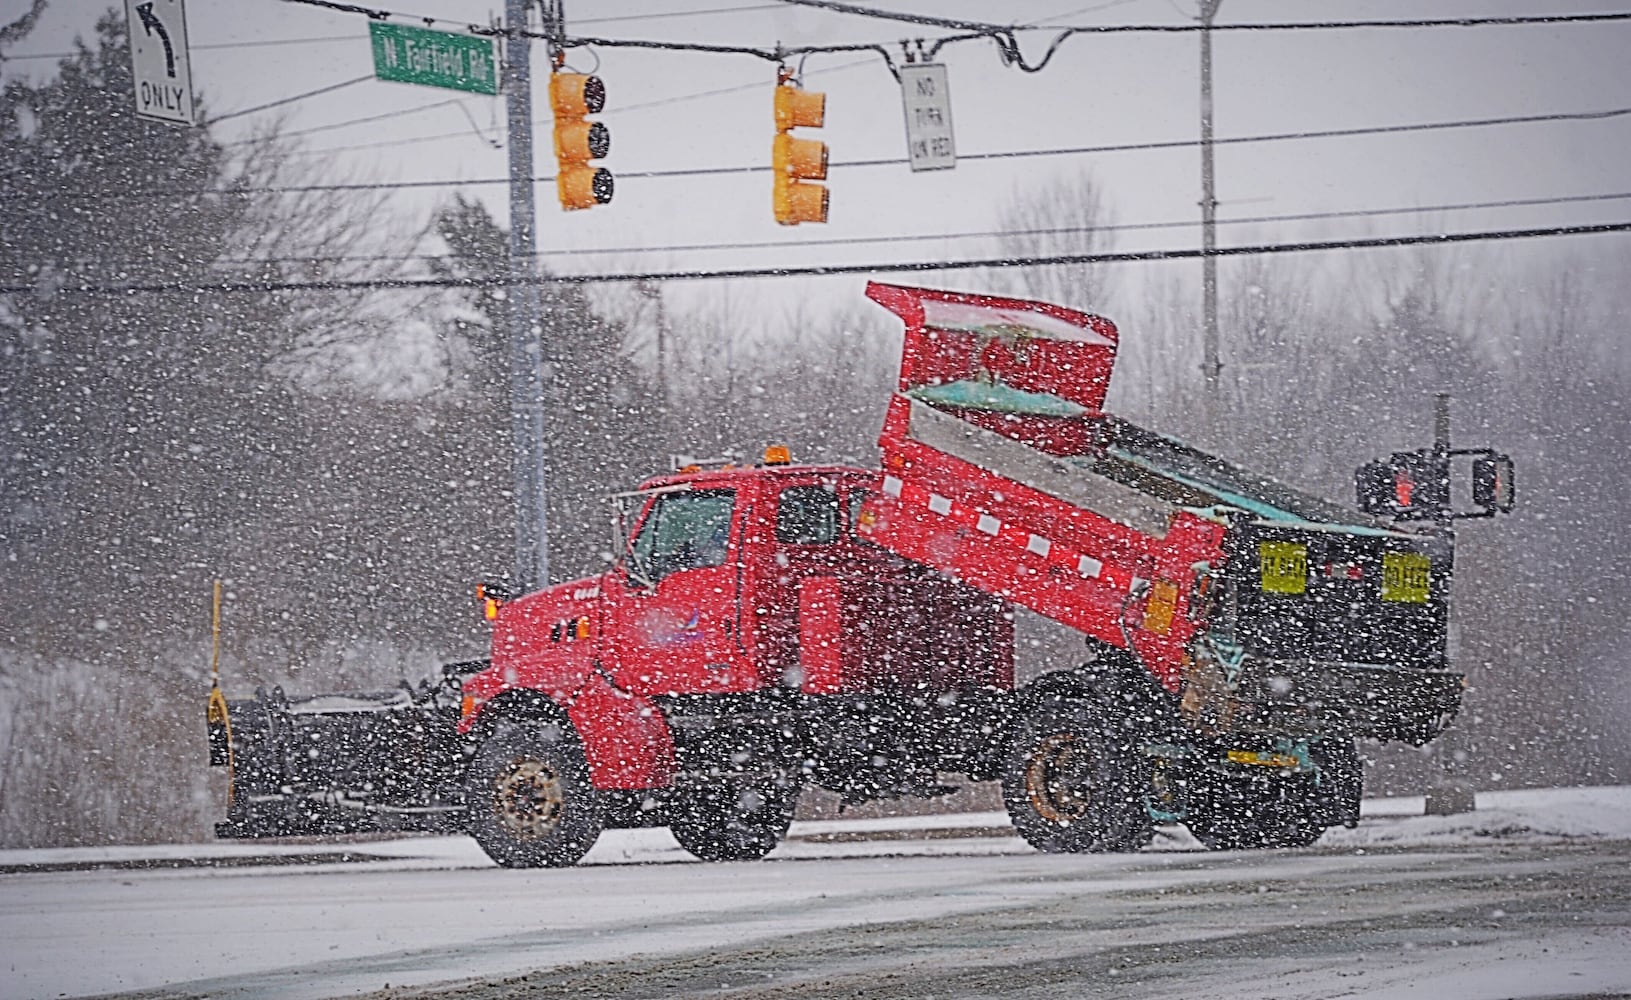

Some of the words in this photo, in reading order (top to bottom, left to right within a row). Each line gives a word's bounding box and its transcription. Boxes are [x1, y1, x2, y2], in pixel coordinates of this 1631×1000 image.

[383, 36, 398, 67] N
[404, 39, 463, 77] Fairfield
[468, 49, 487, 80] Rd
[141, 81, 184, 111] ONLY
[916, 77, 936, 97] NO
